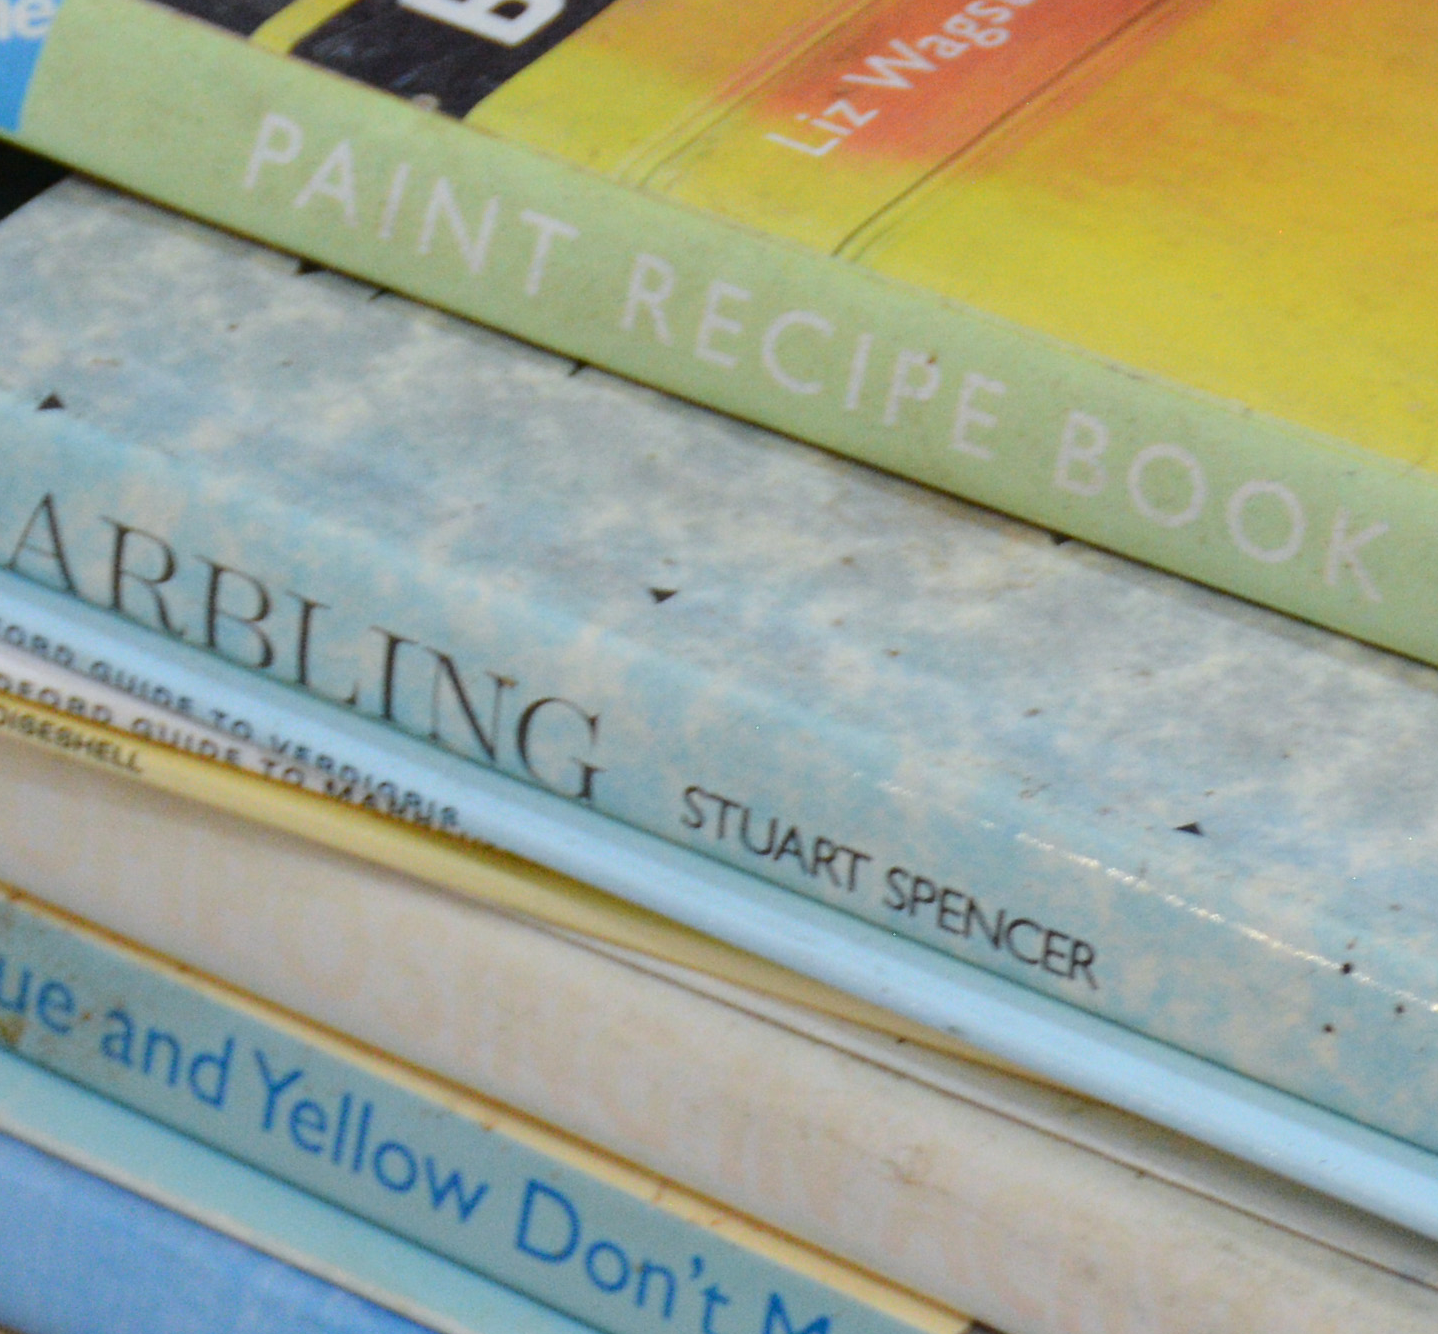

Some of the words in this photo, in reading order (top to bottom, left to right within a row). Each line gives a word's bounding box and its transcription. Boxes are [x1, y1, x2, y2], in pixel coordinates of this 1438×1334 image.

[763, 94, 880, 161] Liz
[245, 113, 580, 297] PAINT
[621, 253, 1005, 461] RECIPE
[1056, 410, 1390, 602] BOOK
[89, 659, 193, 712] GUIDE
[210, 708, 253, 742] TO
[269, 735, 460, 827] VERDIGRIS
[132, 717, 242, 766] GUIDE
[261, 758, 305, 788] TO
[681, 785, 872, 892] STUART
[884, 867, 1100, 990] SPENCER
[100, 1008, 235, 1110] and
[252, 1050, 490, 1223] Yellow
